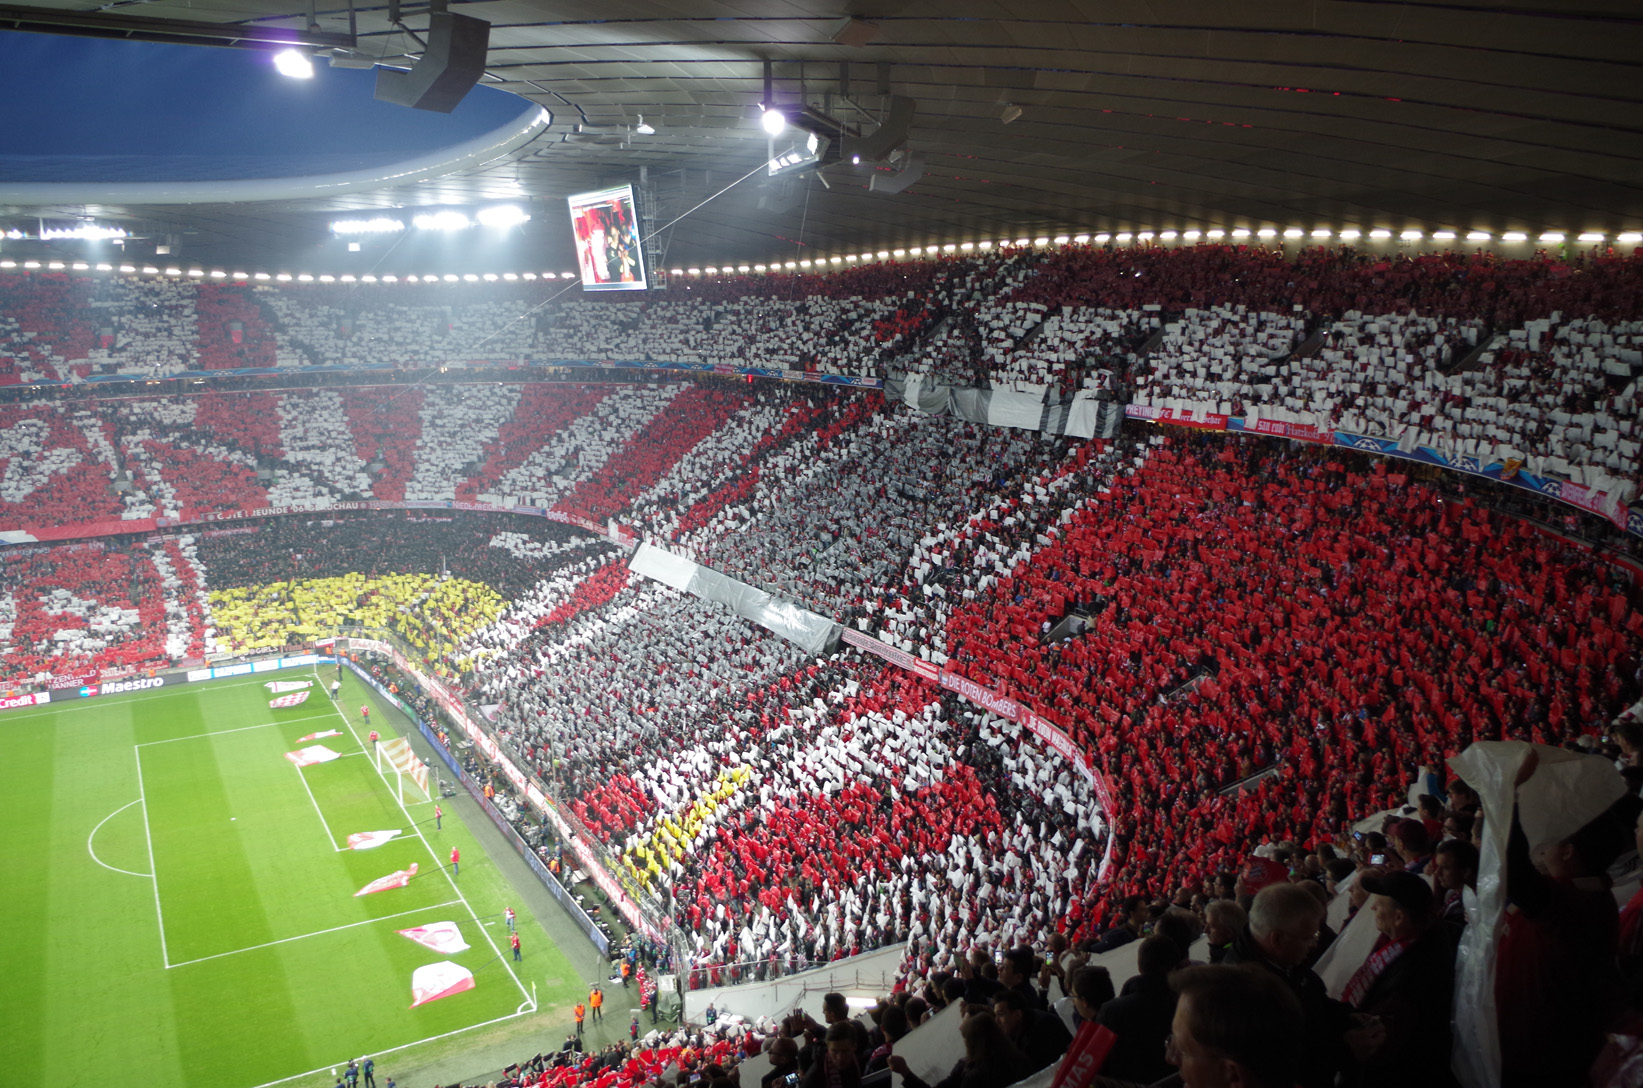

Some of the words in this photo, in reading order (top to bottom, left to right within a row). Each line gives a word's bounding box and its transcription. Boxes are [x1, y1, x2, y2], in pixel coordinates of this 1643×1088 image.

[101, 677, 164, 695] Maestro
[948, 675, 960, 691] DIE
[961, 681, 981, 701] ROTEN
[982, 690, 1017, 718] BOMBERS
